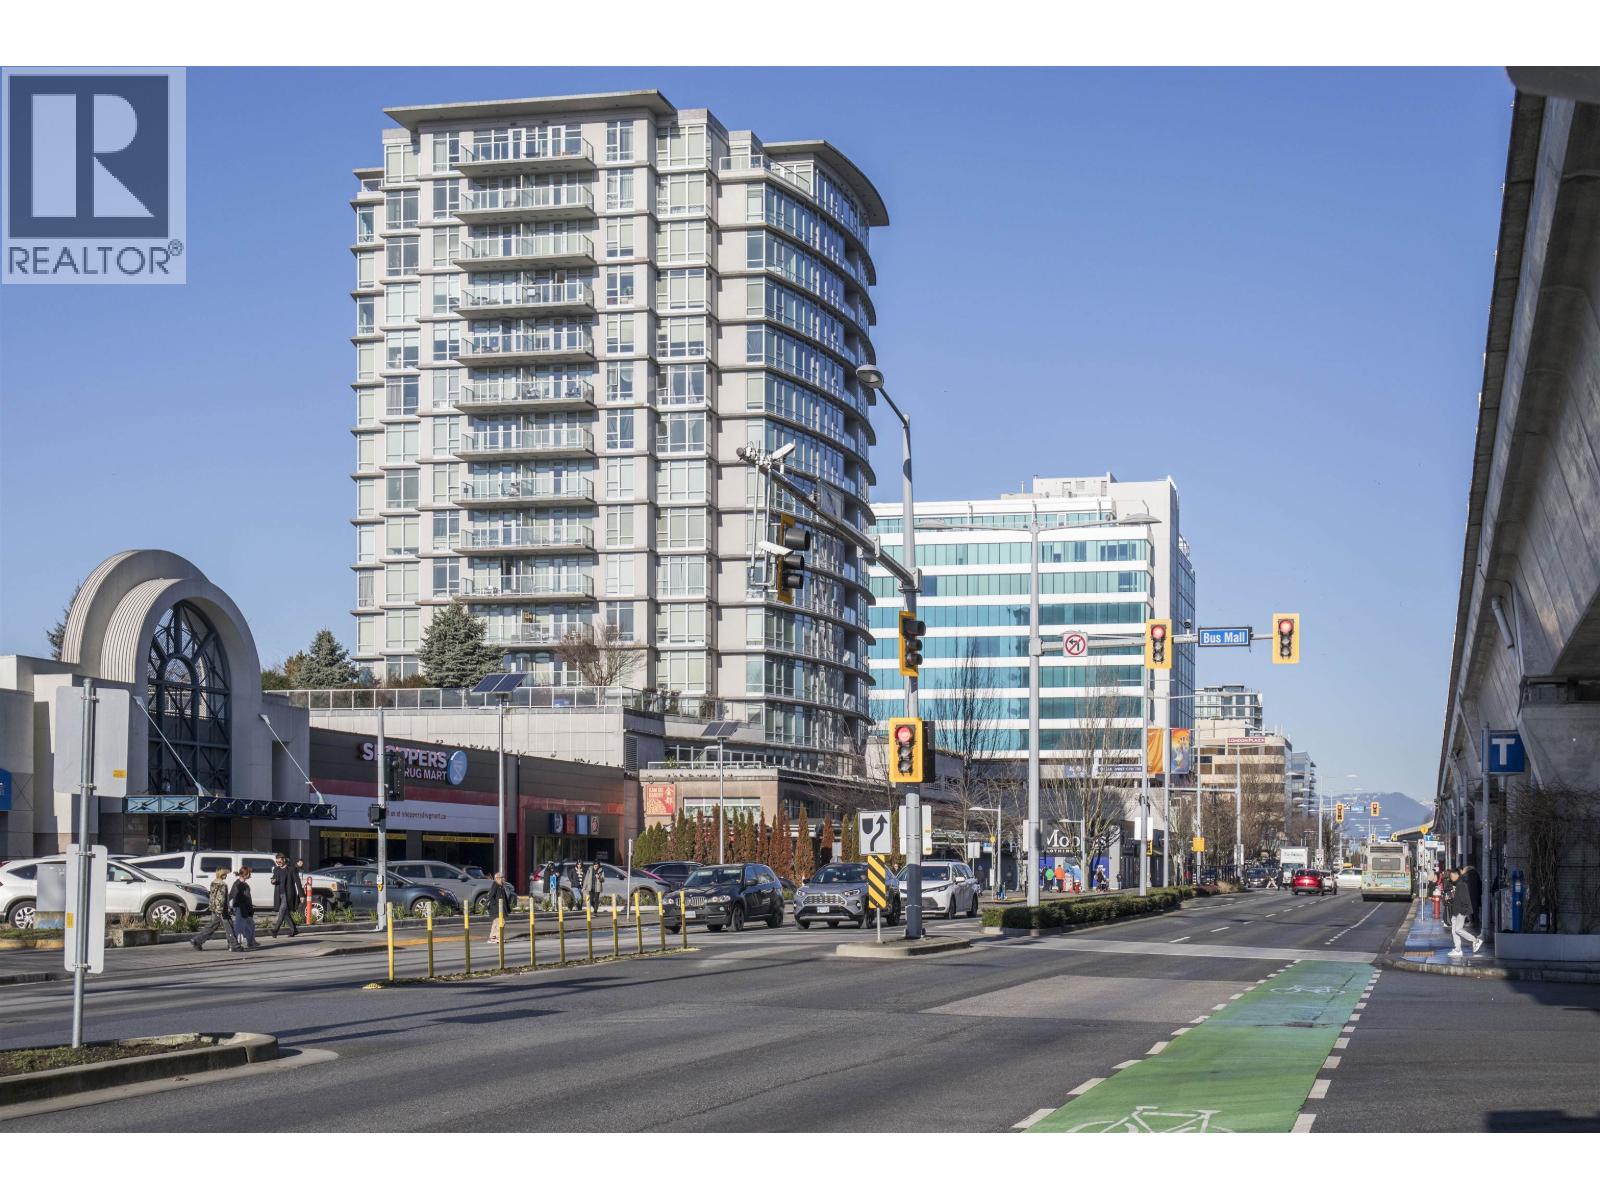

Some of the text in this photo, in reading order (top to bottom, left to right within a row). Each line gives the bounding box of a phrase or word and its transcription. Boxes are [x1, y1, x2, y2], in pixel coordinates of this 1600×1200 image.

[1203, 632, 1245, 643] Bus Mall
[1492, 738, 1515, 765] T
[405, 767, 447, 781] RUG MART
